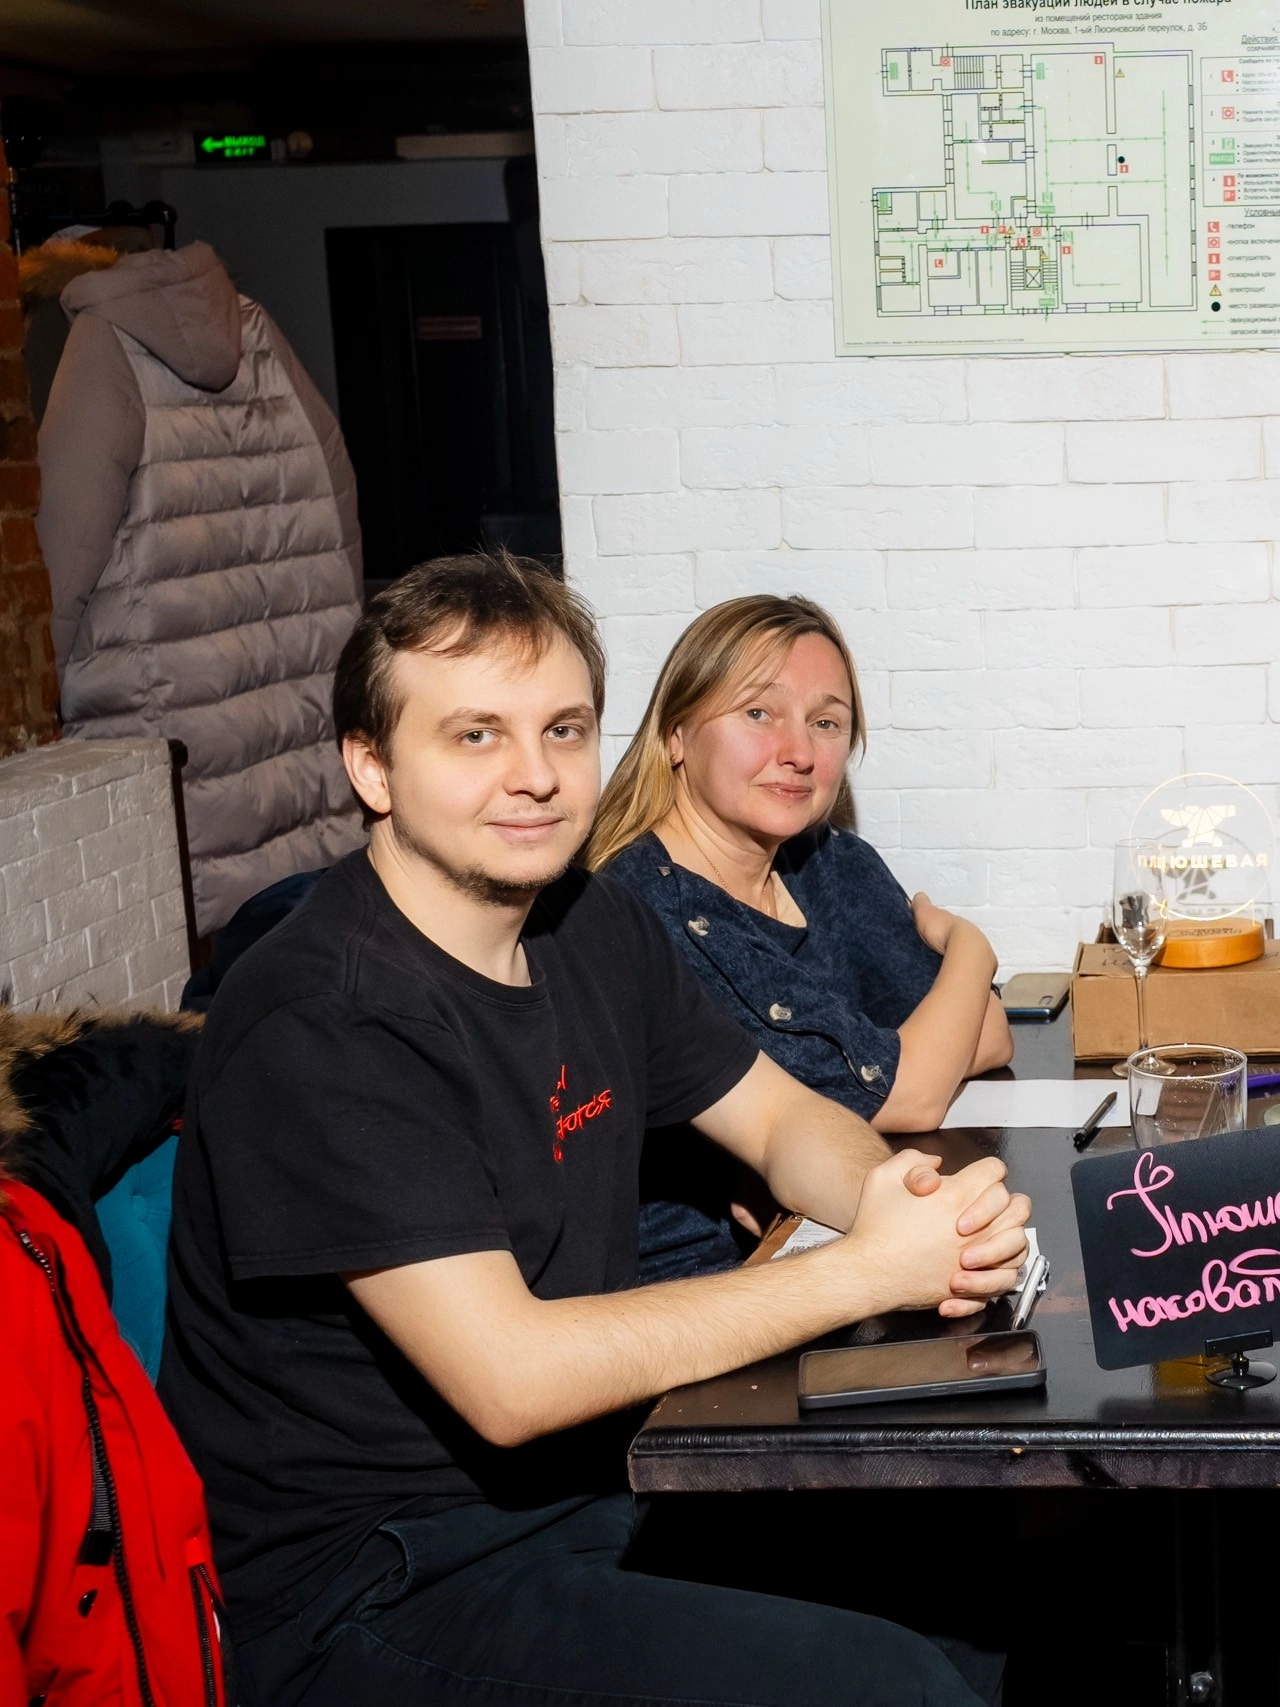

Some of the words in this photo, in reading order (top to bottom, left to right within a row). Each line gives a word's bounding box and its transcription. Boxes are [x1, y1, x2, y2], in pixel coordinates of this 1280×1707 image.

[966, 0, 998, 9] План
[1002, 0, 1070, 11] эвакуации
[1046, 13, 1090, 22] помещений
[1092, 12, 1133, 21] ресторана
[1135, 11, 1162, 20] здания
[1041, 26, 1071, 35] Москва,
[1094, 23, 1145, 33] Люсиновский
[1147, 24, 1185, 33] переулок,
[224, 135, 266, 147] ВЫХОД
[224, 147, 255, 157] EXIT
